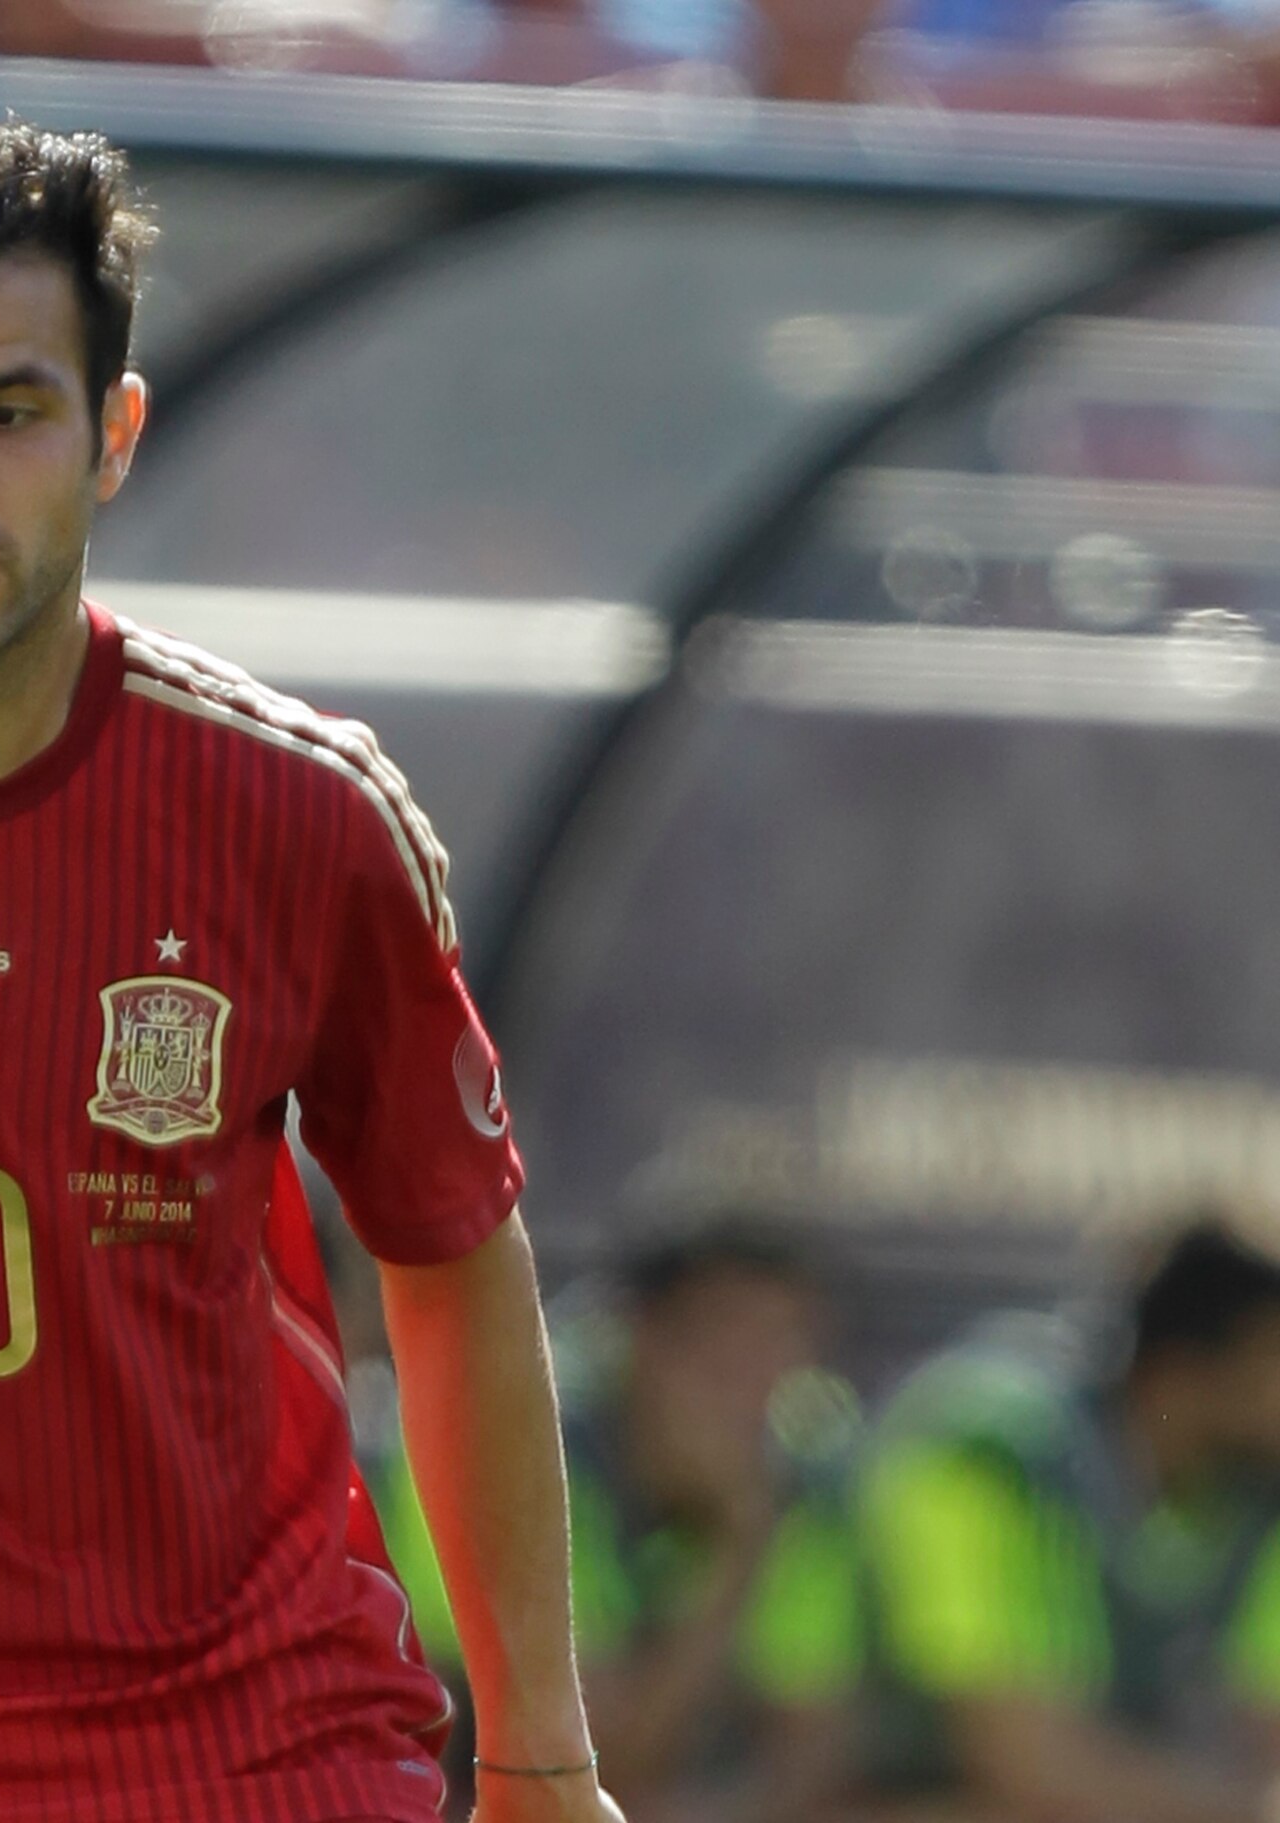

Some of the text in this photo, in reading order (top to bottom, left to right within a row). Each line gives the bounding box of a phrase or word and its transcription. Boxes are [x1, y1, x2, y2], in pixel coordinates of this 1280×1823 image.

[122, 1174, 139, 1194] VS
[104, 1201, 114, 1219] 7
[160, 1202, 192, 1221] 2014
